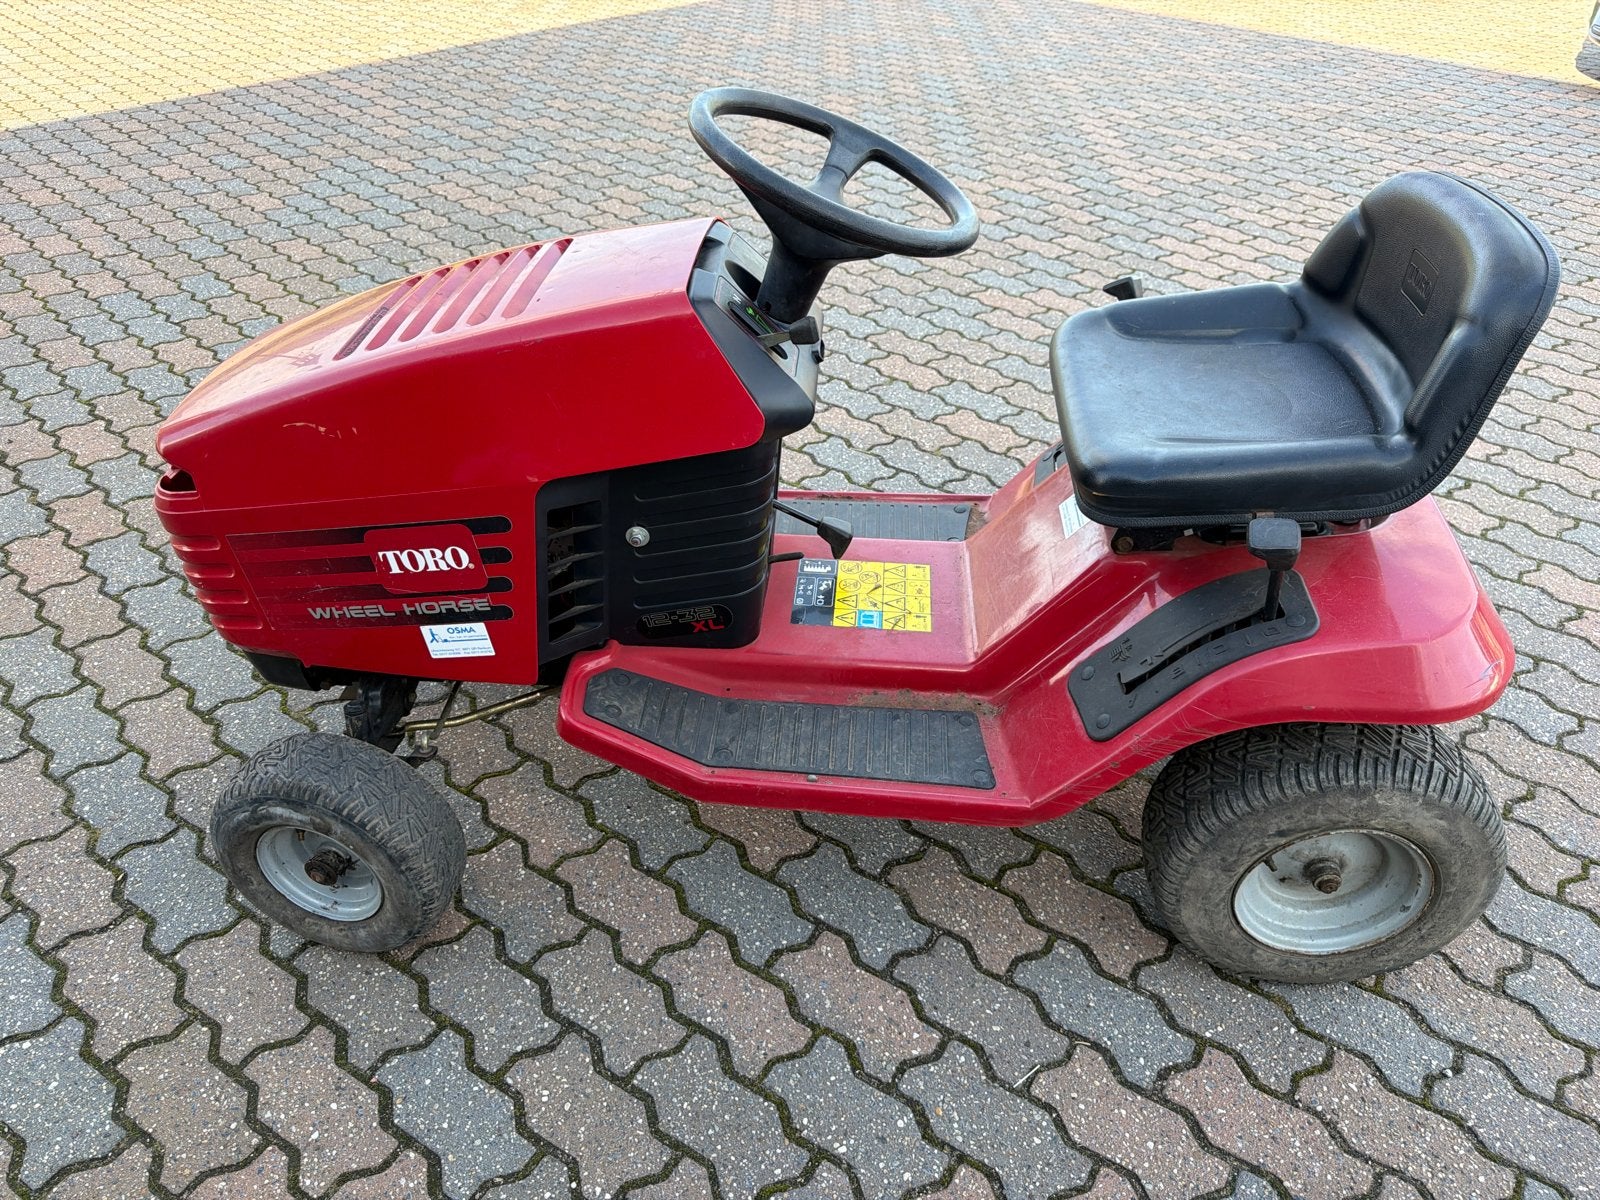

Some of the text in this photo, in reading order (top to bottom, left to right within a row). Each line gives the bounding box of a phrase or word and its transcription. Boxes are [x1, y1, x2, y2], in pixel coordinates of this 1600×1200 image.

[378, 546, 470, 574] TORO
[307, 598, 492, 620] WHEEL HORSE
[641, 606, 717, 628] 12-32
[446, 626, 477, 635] OSMA
[690, 618, 725, 633] XL
